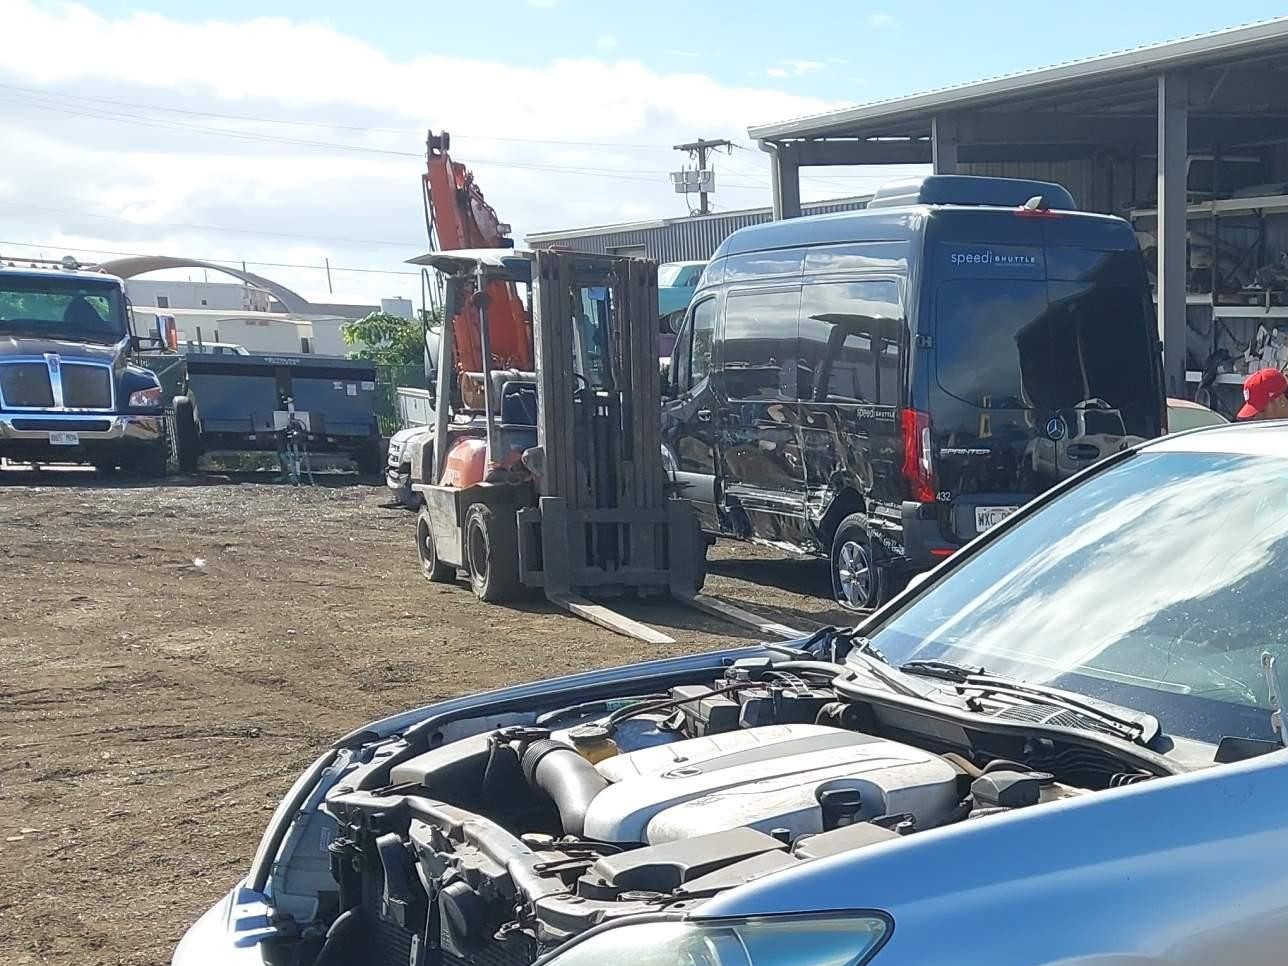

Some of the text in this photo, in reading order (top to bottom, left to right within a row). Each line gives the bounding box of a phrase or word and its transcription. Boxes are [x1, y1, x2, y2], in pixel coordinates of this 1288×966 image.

[951, 250, 1035, 266] speedi SHUTTLE
[935, 491, 951, 501] 432
[977, 512, 996, 527] WXC
